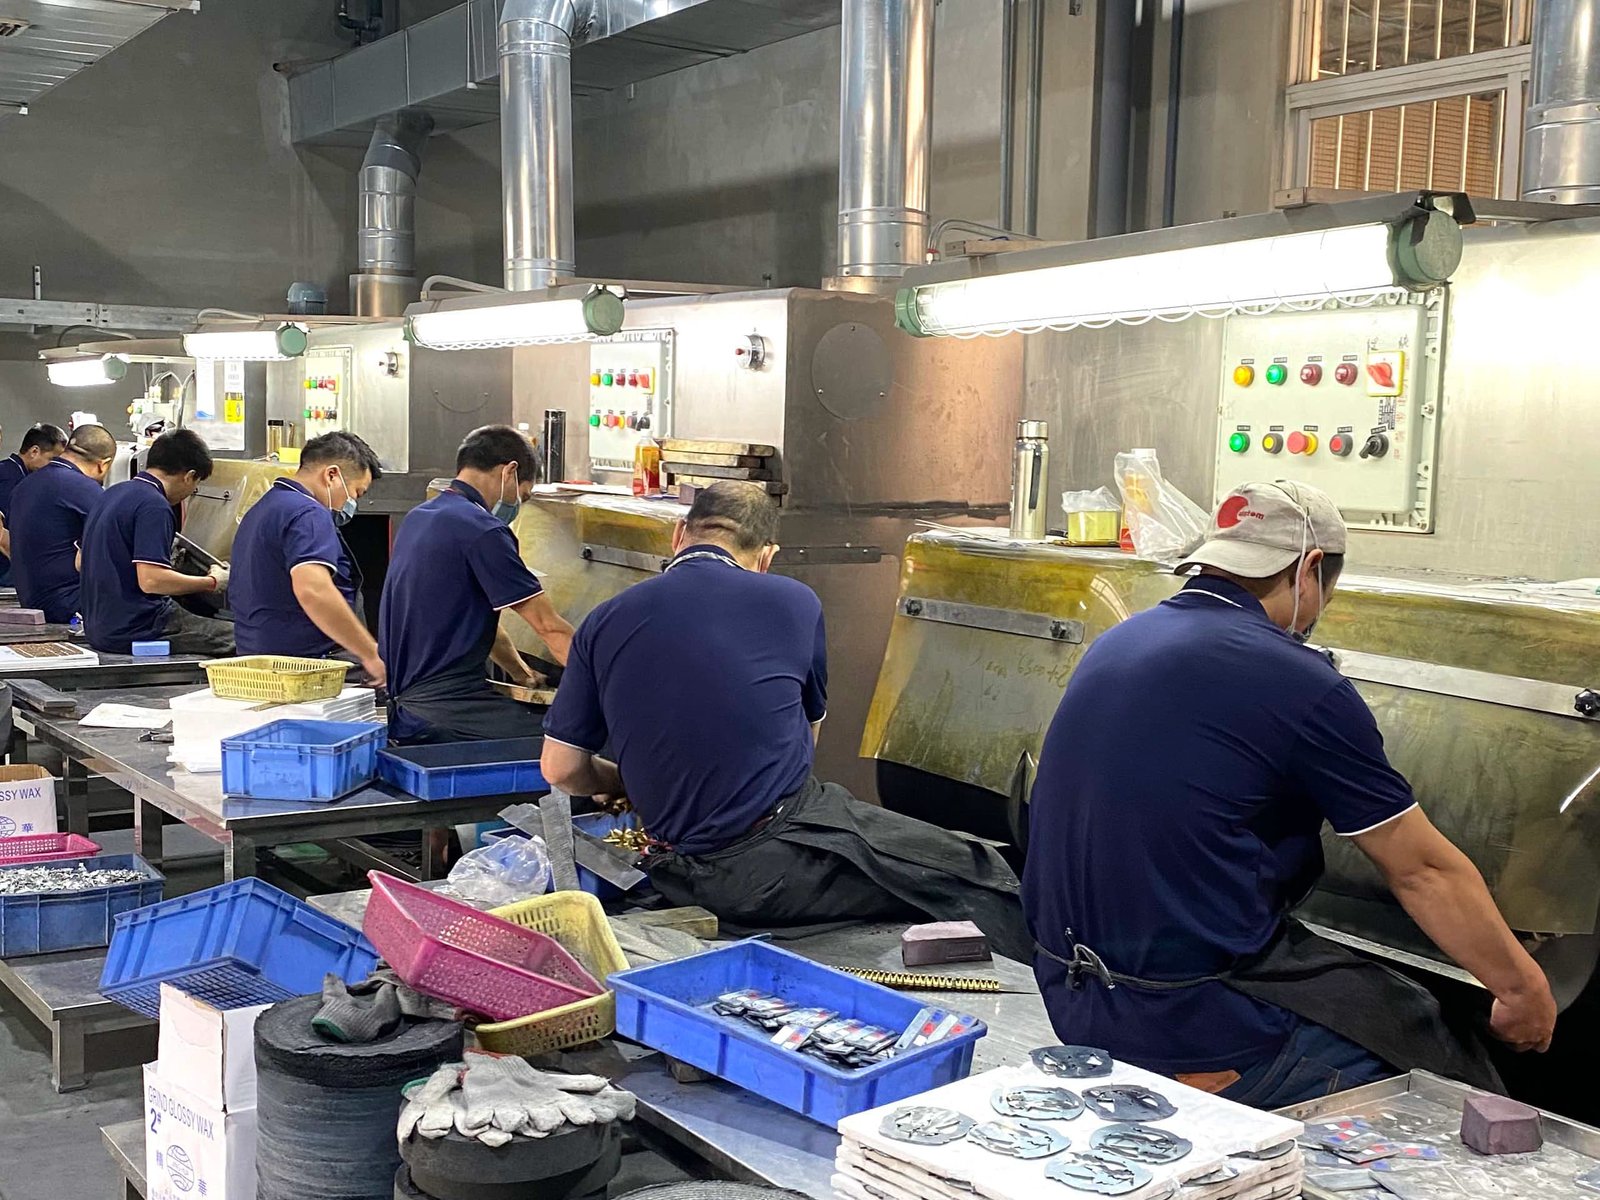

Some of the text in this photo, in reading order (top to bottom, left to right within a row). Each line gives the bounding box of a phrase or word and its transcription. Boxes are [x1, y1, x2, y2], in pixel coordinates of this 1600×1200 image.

[19, 787, 42, 800] WAX
[148, 1085, 214, 1141] GRIND GLOSSY WAX
